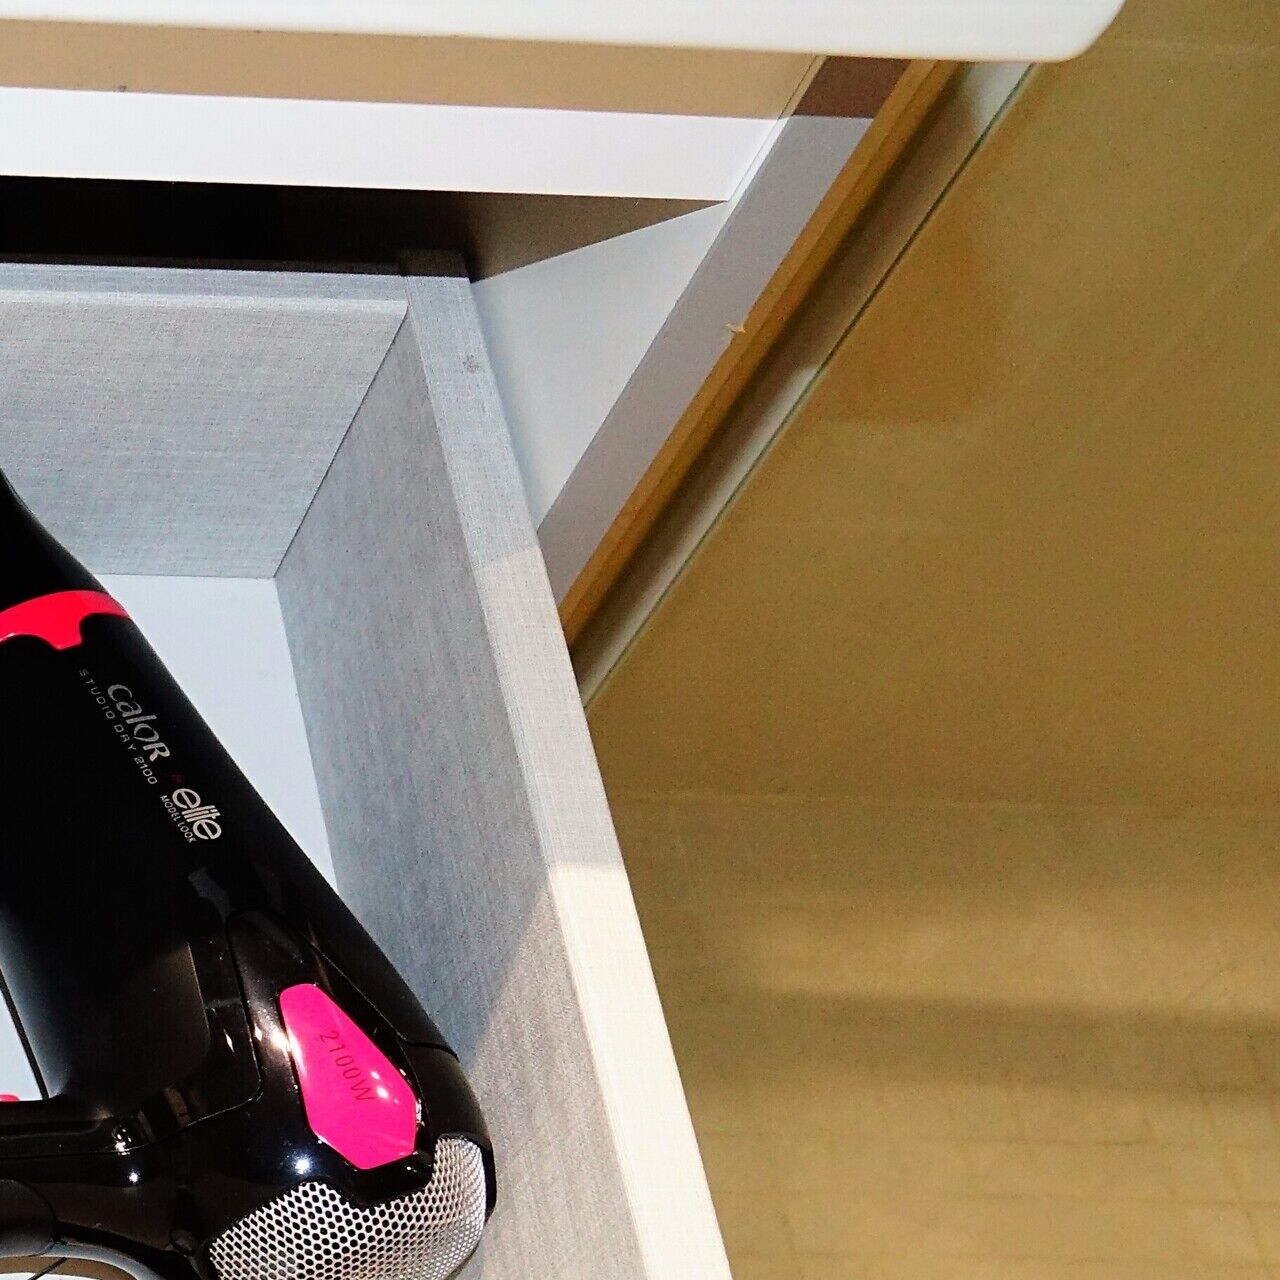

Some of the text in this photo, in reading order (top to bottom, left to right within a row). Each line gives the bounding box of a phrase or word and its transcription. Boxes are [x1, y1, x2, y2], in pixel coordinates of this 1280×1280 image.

[78, 668, 158, 786] STUDIO DRY 2100
[159, 794, 197, 844] MODEL LOOK
[172, 788, 222, 840] elite
[320, 1030, 376, 1100] 2100W
